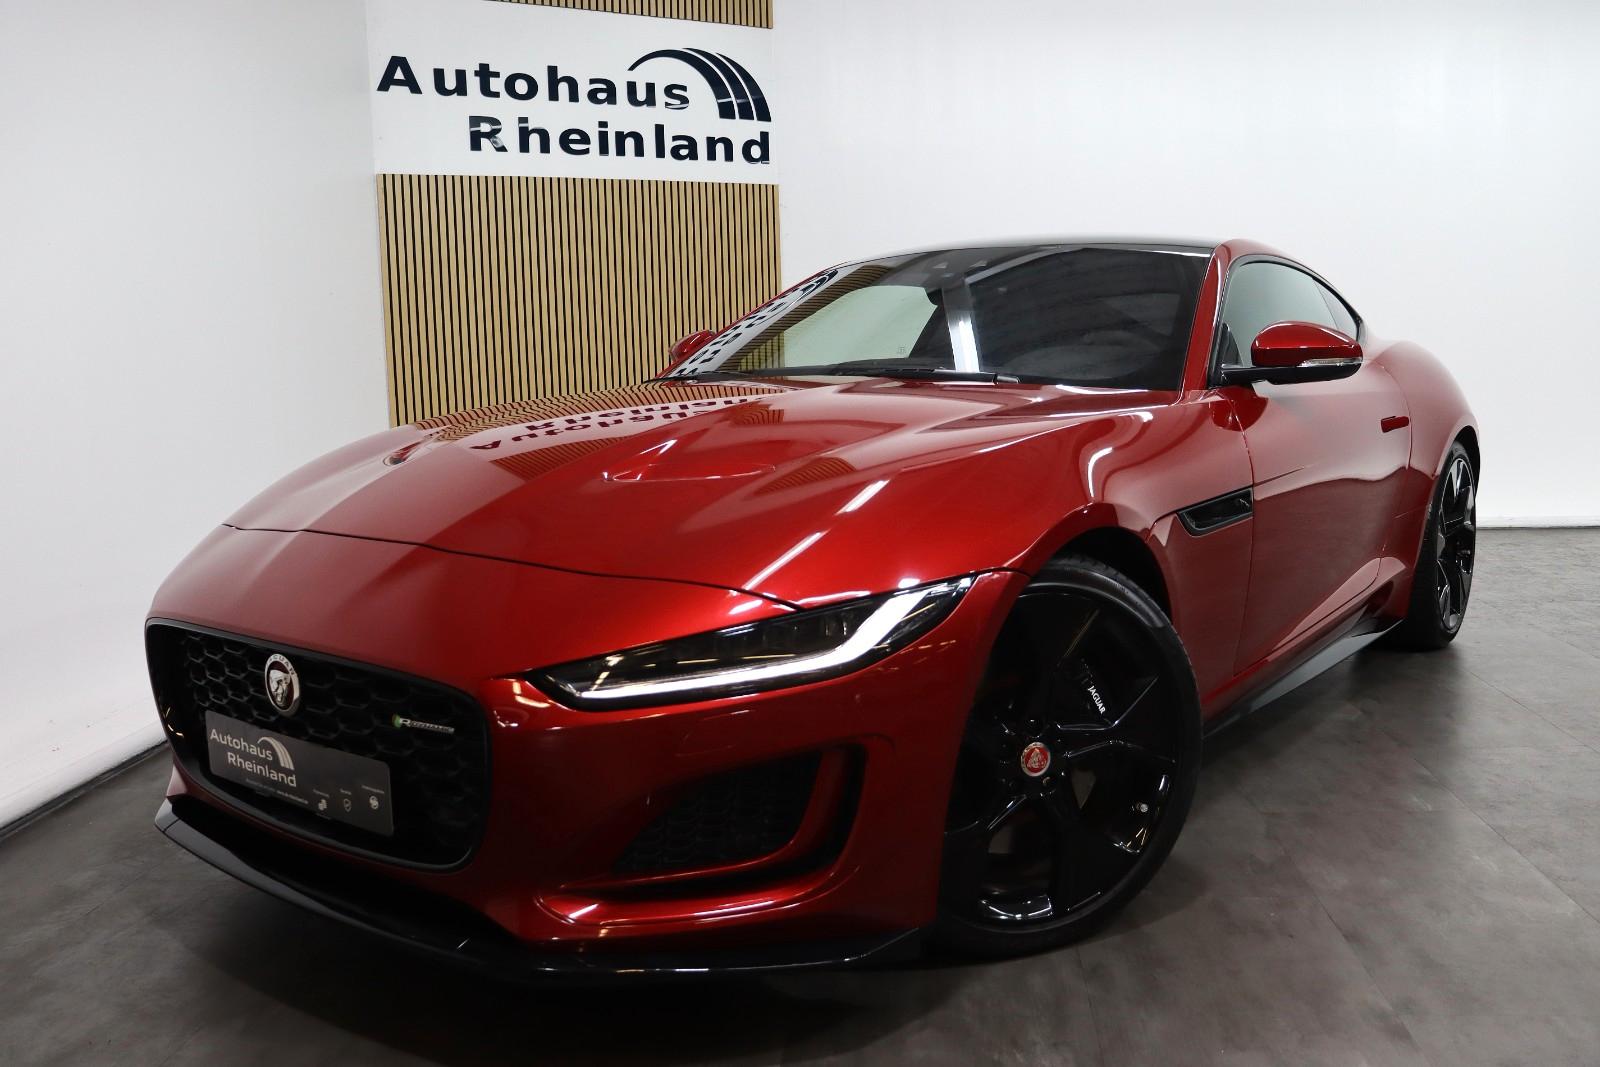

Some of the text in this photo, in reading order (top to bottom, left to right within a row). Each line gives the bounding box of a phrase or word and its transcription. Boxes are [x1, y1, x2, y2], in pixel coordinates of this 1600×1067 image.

[376, 55, 691, 110] Autohaus
[468, 115, 770, 165] Rheinland
[1087, 685, 1106, 715] JAGUAR
[210, 728, 273, 761] Autohaus
[227, 751, 297, 788] Rheinland
